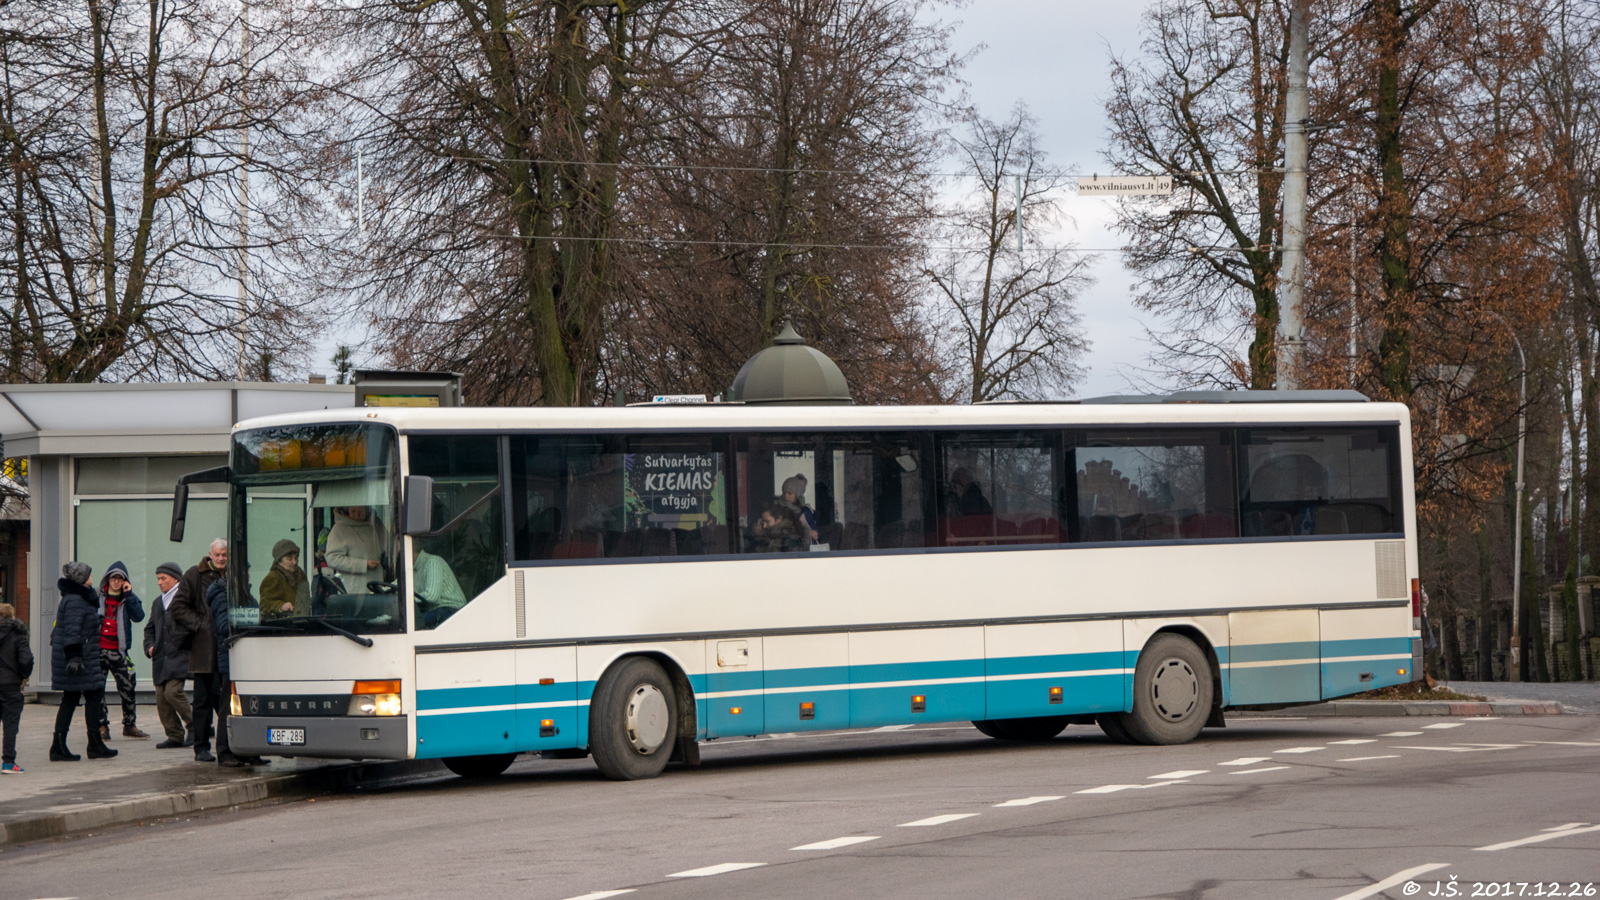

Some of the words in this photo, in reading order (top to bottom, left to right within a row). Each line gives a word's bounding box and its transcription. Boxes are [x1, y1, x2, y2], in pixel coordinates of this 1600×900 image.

[1079, 182, 1154, 191] www.vilniausvt.lt
[644, 454, 712, 470] Sutvarkytas
[645, 471, 713, 491] KIEMAS
[661, 493, 698, 510] atgyja
[268, 701, 332, 709] SETRA
[271, 730, 286, 741] KBF
[290, 730, 303, 742] 289
